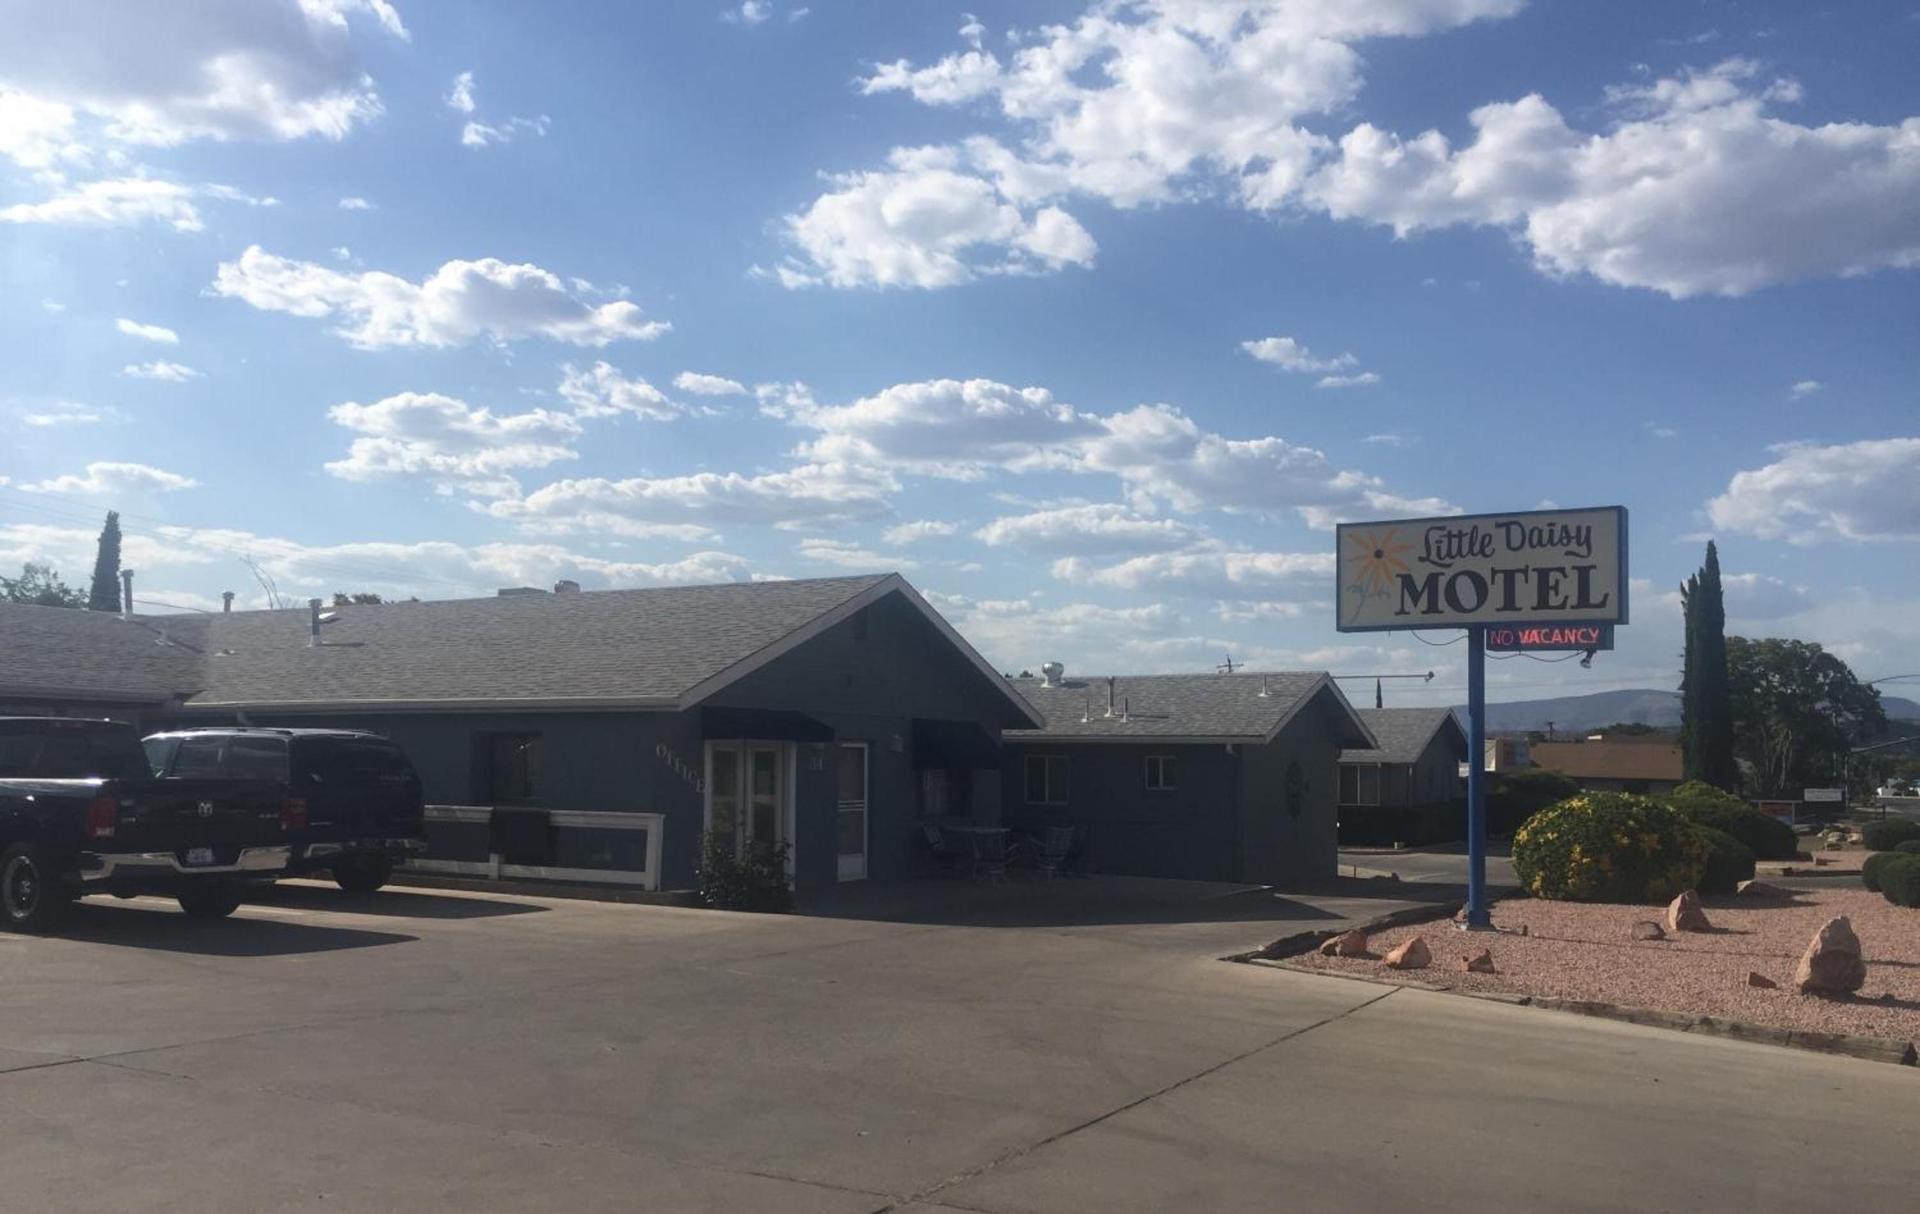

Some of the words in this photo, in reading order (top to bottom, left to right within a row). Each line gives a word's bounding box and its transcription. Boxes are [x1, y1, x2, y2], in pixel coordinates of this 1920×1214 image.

[1417, 525, 1495, 568] Little
[1495, 520, 1593, 558] Daisy
[1394, 564, 1610, 616] MOTEL
[1489, 629, 1514, 646] NO
[1518, 627, 1600, 645] VACANCY
[656, 742, 704, 793] OFFICE
